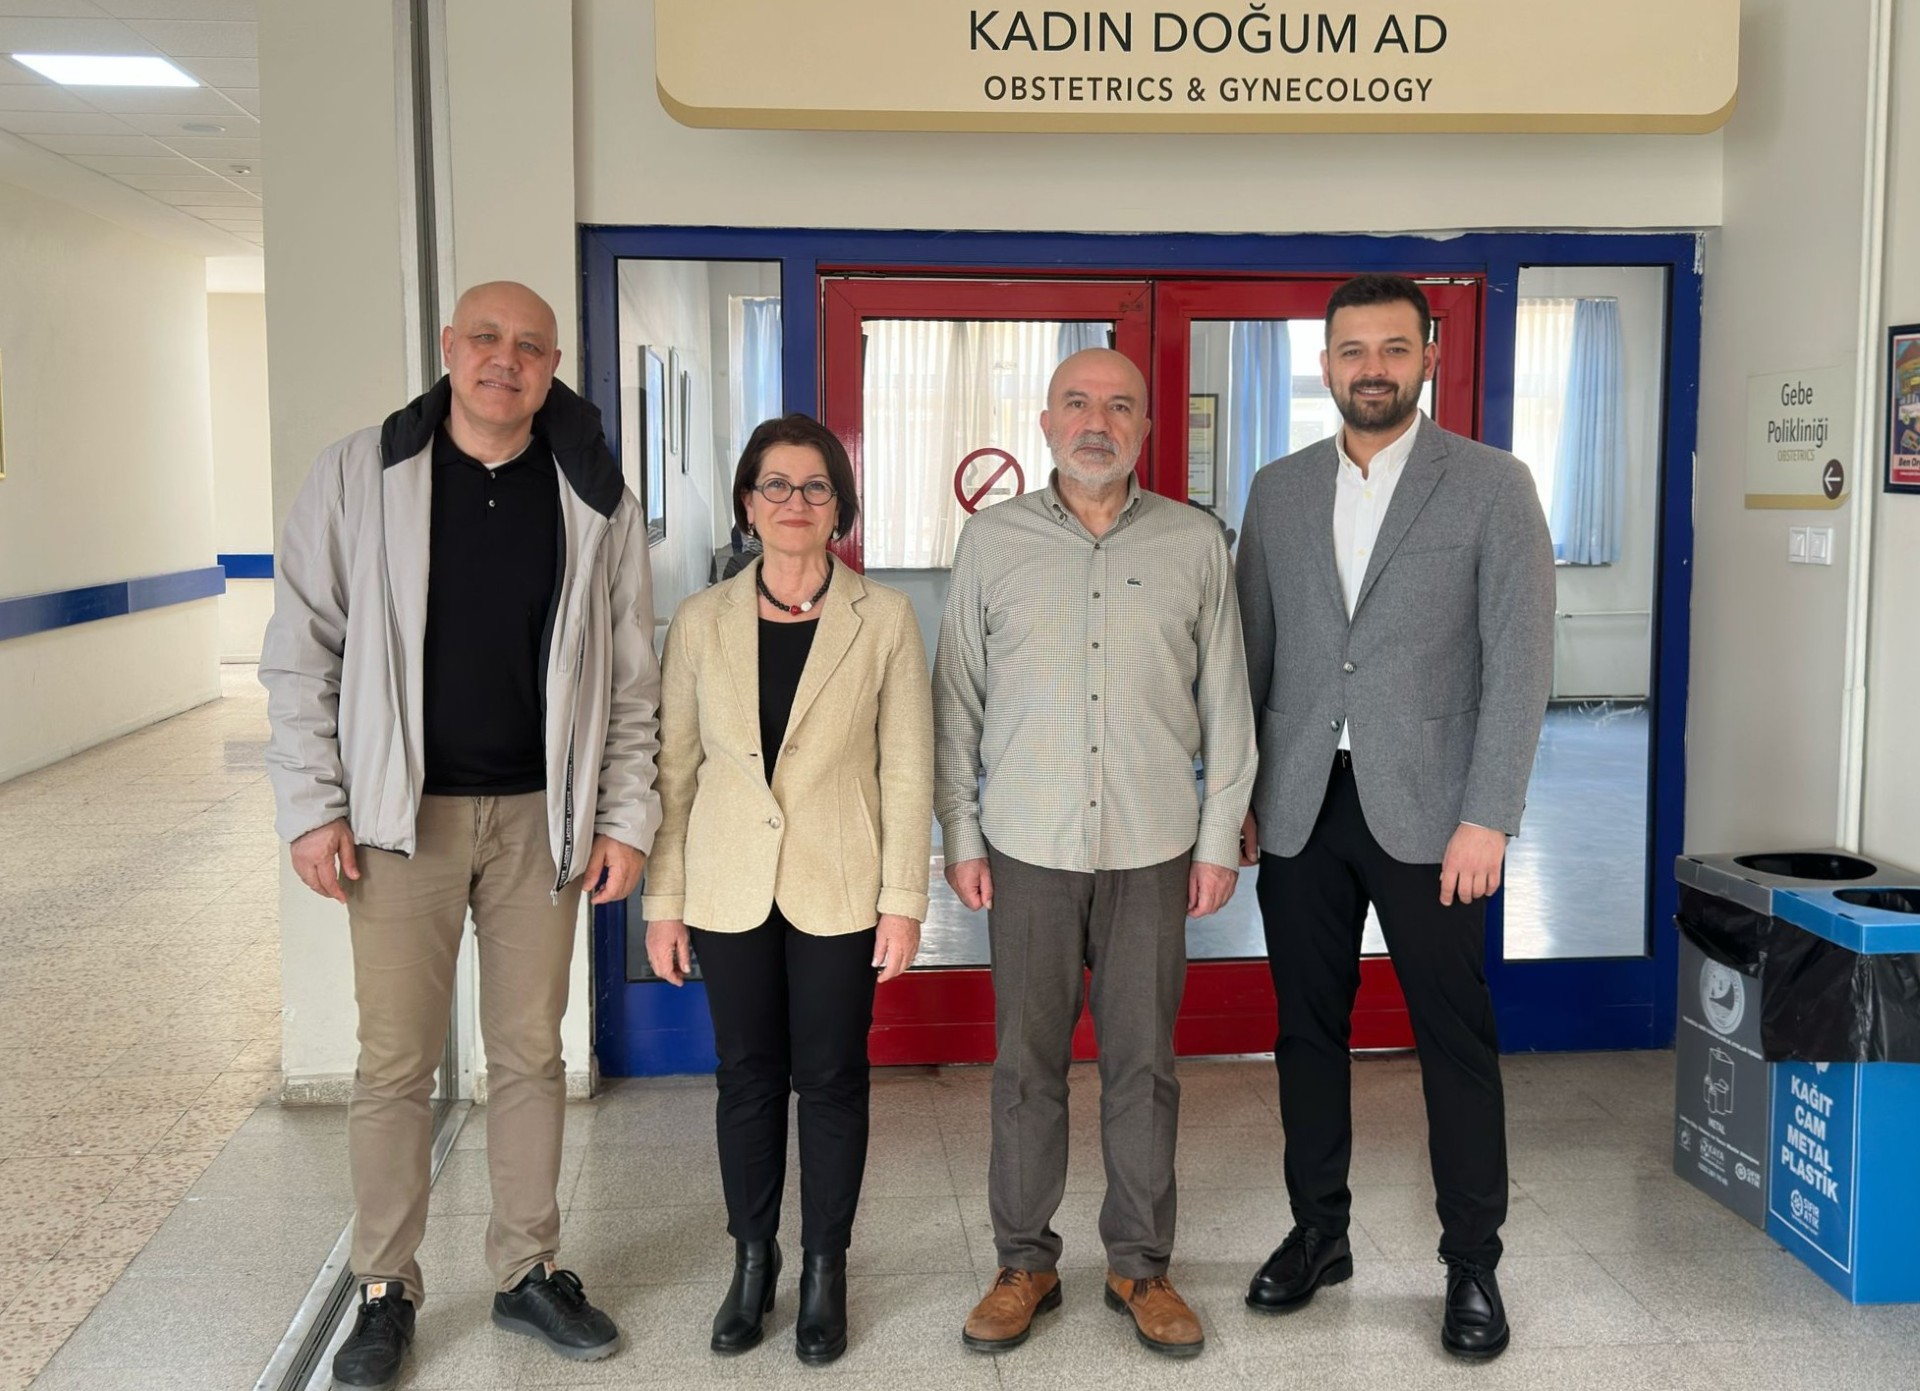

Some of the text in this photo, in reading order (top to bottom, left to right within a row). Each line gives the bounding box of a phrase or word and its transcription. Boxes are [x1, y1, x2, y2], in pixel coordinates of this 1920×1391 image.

[969, 2, 1448, 55] KADIN DOĞUM AD
[984, 75, 1433, 103] OBSTETRICS & GYNECOLOGY
[1781, 380, 1814, 407] Gebe
[1767, 417, 1829, 449] Polikliniği
[1777, 449, 1816, 463] OBSTETRICS
[563, 845, 571, 867] LACOSTE
[1791, 1074, 1834, 1118] KAĞIT
[1794, 1104, 1827, 1142] CAM
[1787, 1123, 1833, 1173] METAL
[1781, 1144, 1839, 1204] PLASTİK
